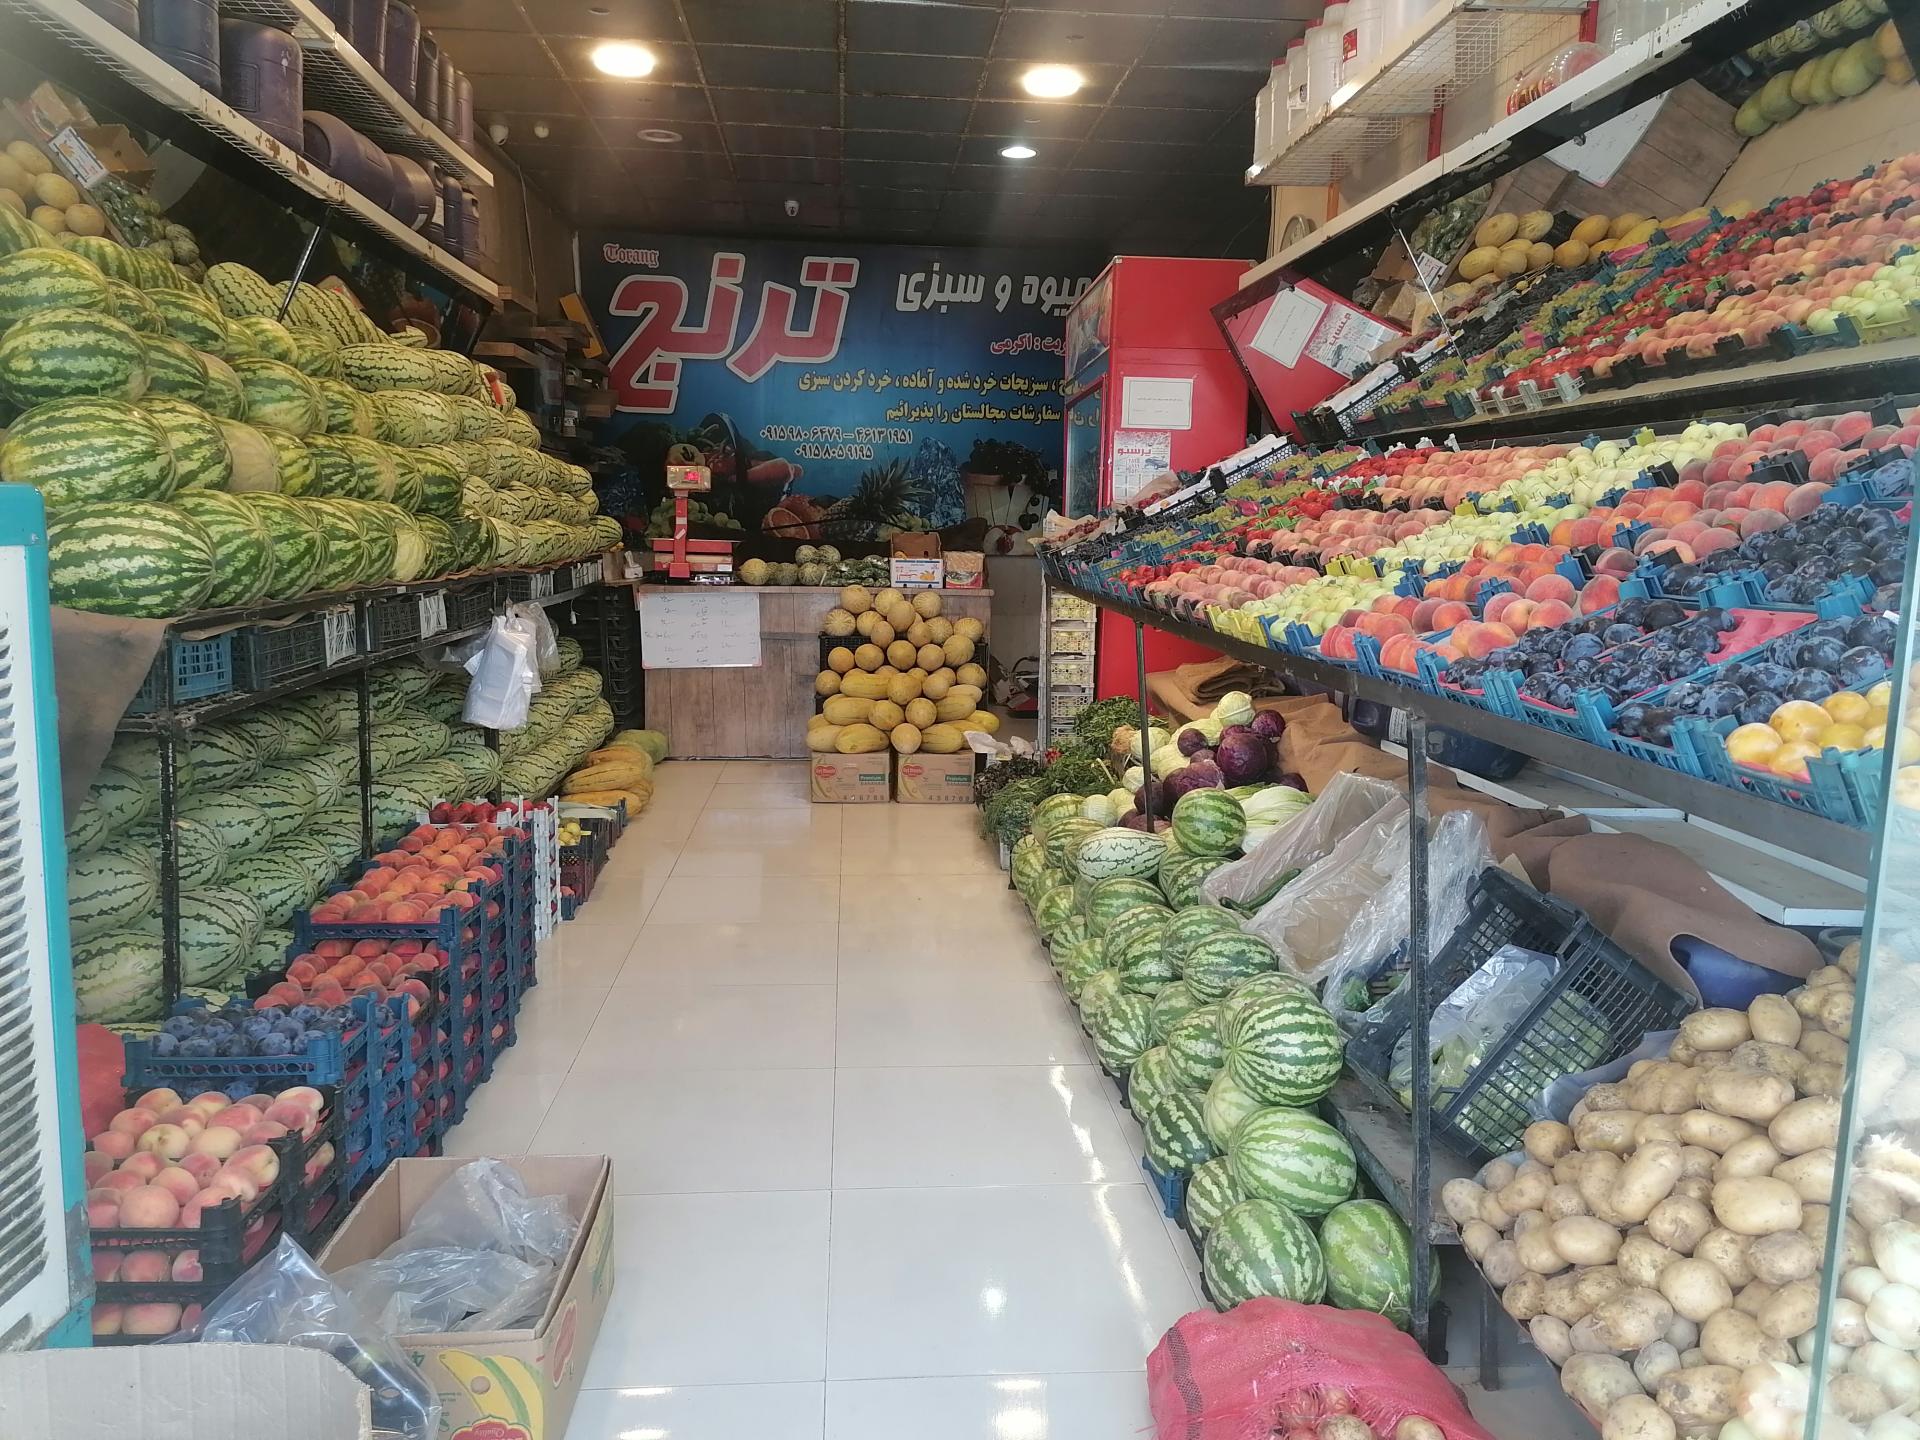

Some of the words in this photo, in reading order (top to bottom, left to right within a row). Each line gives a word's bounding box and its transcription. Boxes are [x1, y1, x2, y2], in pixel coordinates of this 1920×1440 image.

[603, 243, 659, 268] Torang
[895, 262, 986, 313] سبزی
[994, 274, 1012, 313] و
[607, 252, 860, 415] ترنج
[990, 332, 1033, 355] اکرمی
[798, 370, 831, 391] سبزی
[832, 368, 866, 393] کردن
[867, 369, 892, 393] خرد
[946, 371, 971, 389] شده
[1000, 373, 1048, 396] سبزیجات
[936, 401, 949, 423] را
[1009, 404, 1061, 425] سفارشات
